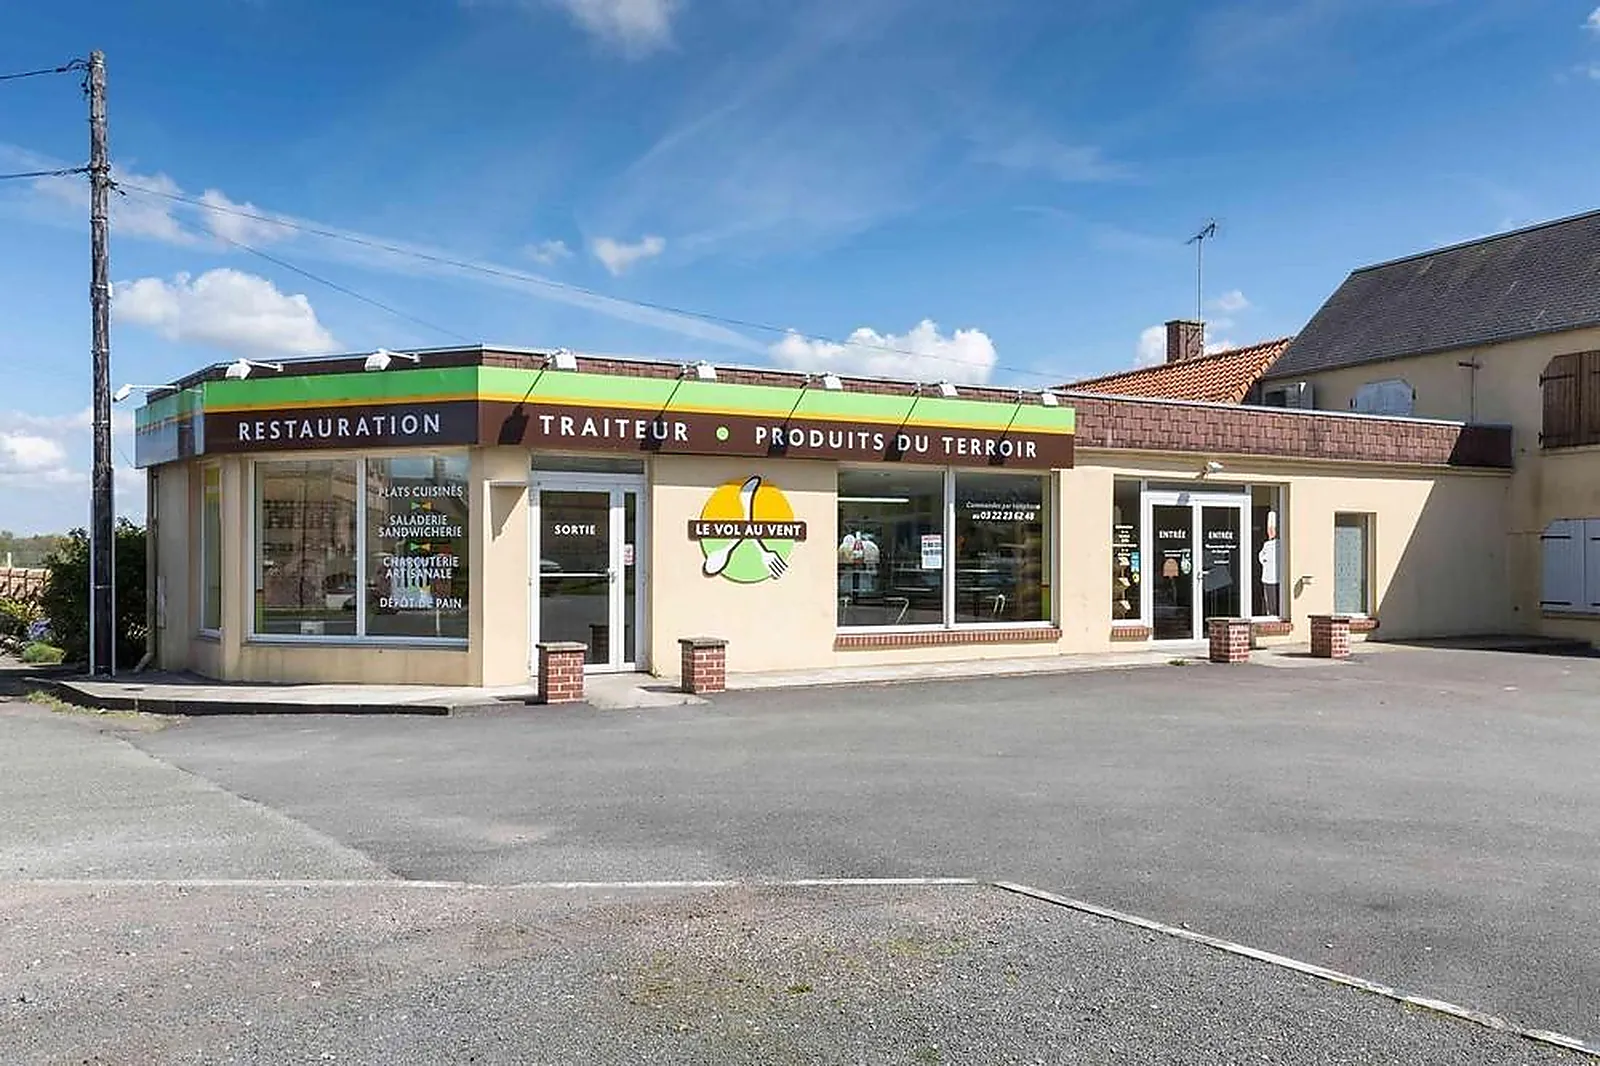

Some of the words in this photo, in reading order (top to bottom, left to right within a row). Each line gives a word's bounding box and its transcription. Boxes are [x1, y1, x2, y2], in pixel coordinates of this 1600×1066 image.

[238, 413, 440, 441] RESTAURATION
[539, 415, 688, 441] TRAITEUR
[755, 426, 884, 451] PRODUITS
[897, 434, 929, 452] DU
[942, 436, 1037, 458] TERROIR
[389, 514, 448, 526] SALADERIE
[378, 525, 462, 538] SANDWICHERIE
[554, 524, 596, 536] SORTIE
[695, 523, 710, 536] LE
[716, 523, 741, 536] VOL
[744, 523, 763, 536] AU
[767, 523, 801, 536] VENT
[385, 567, 452, 579] ARTISANALE
[436, 597, 462, 608] PAIN
